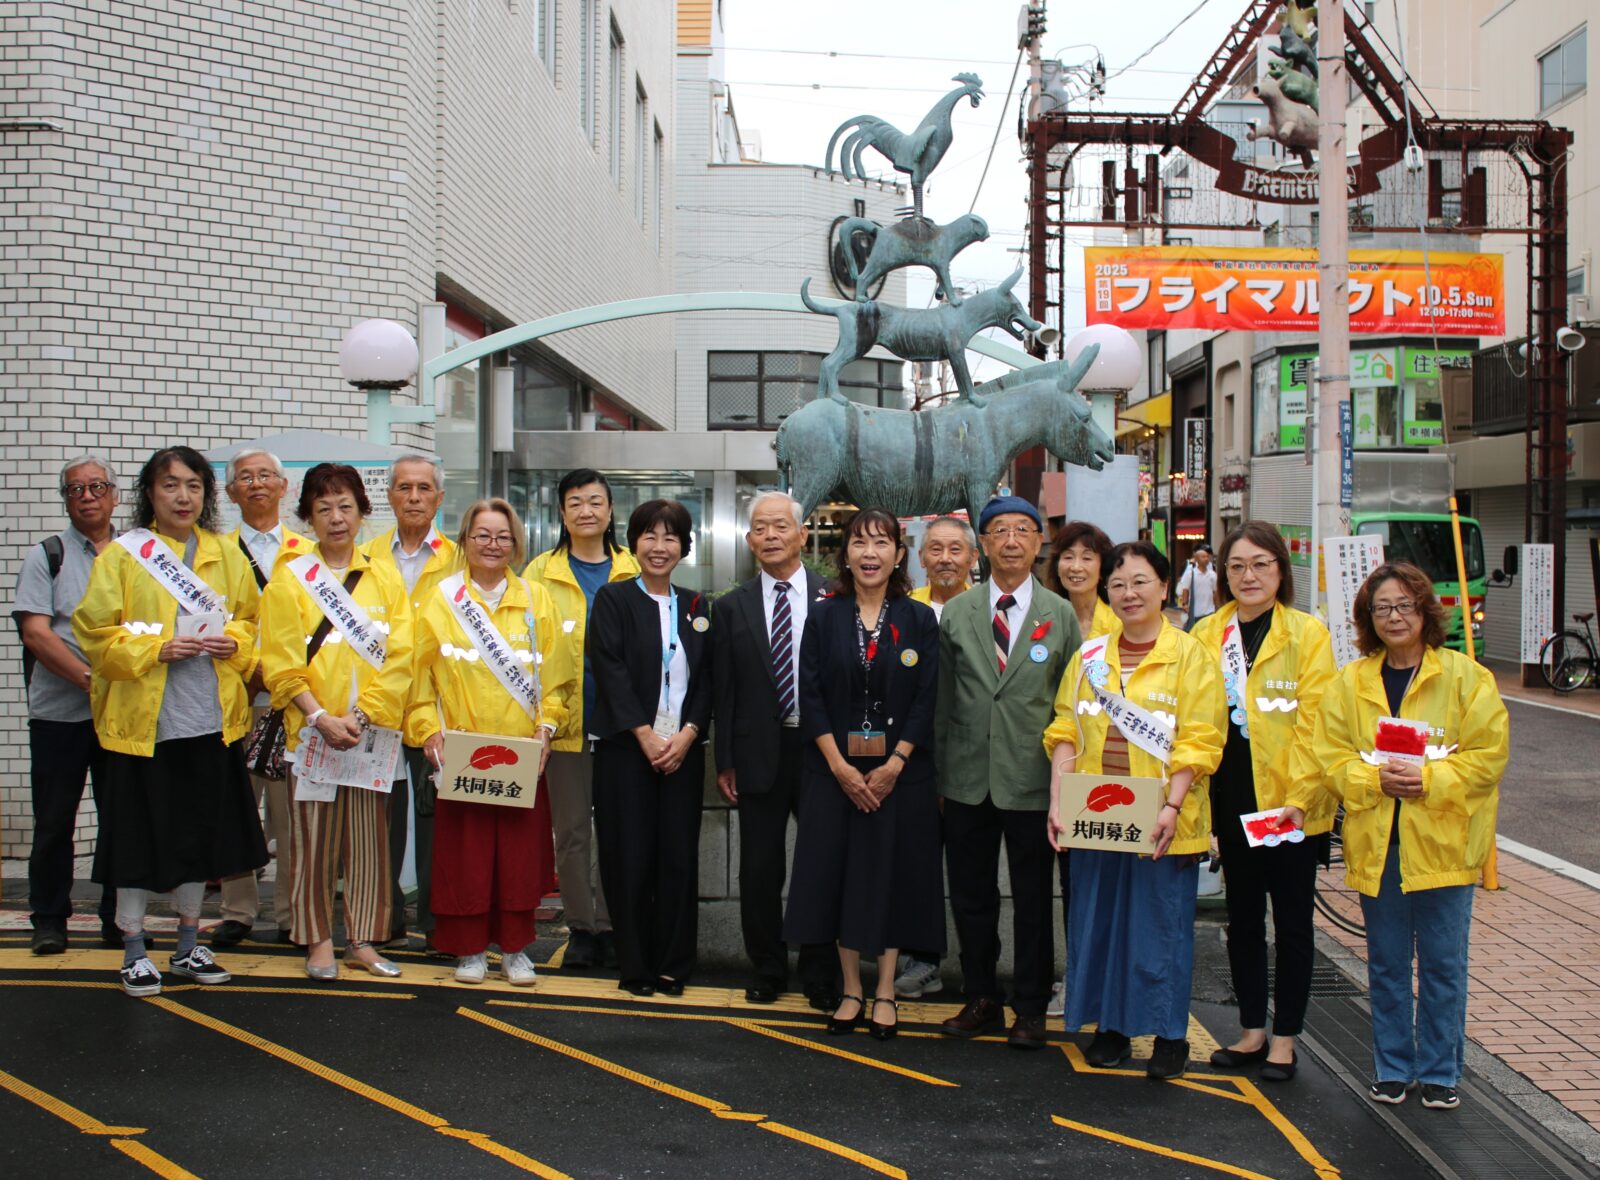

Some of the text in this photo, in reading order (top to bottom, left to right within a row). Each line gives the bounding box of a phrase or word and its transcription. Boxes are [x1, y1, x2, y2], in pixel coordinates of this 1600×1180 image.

[1095, 264, 1128, 276] 2025
[453, 775, 523, 798] 共同募金
[1072, 820, 1142, 843] 共同募金
